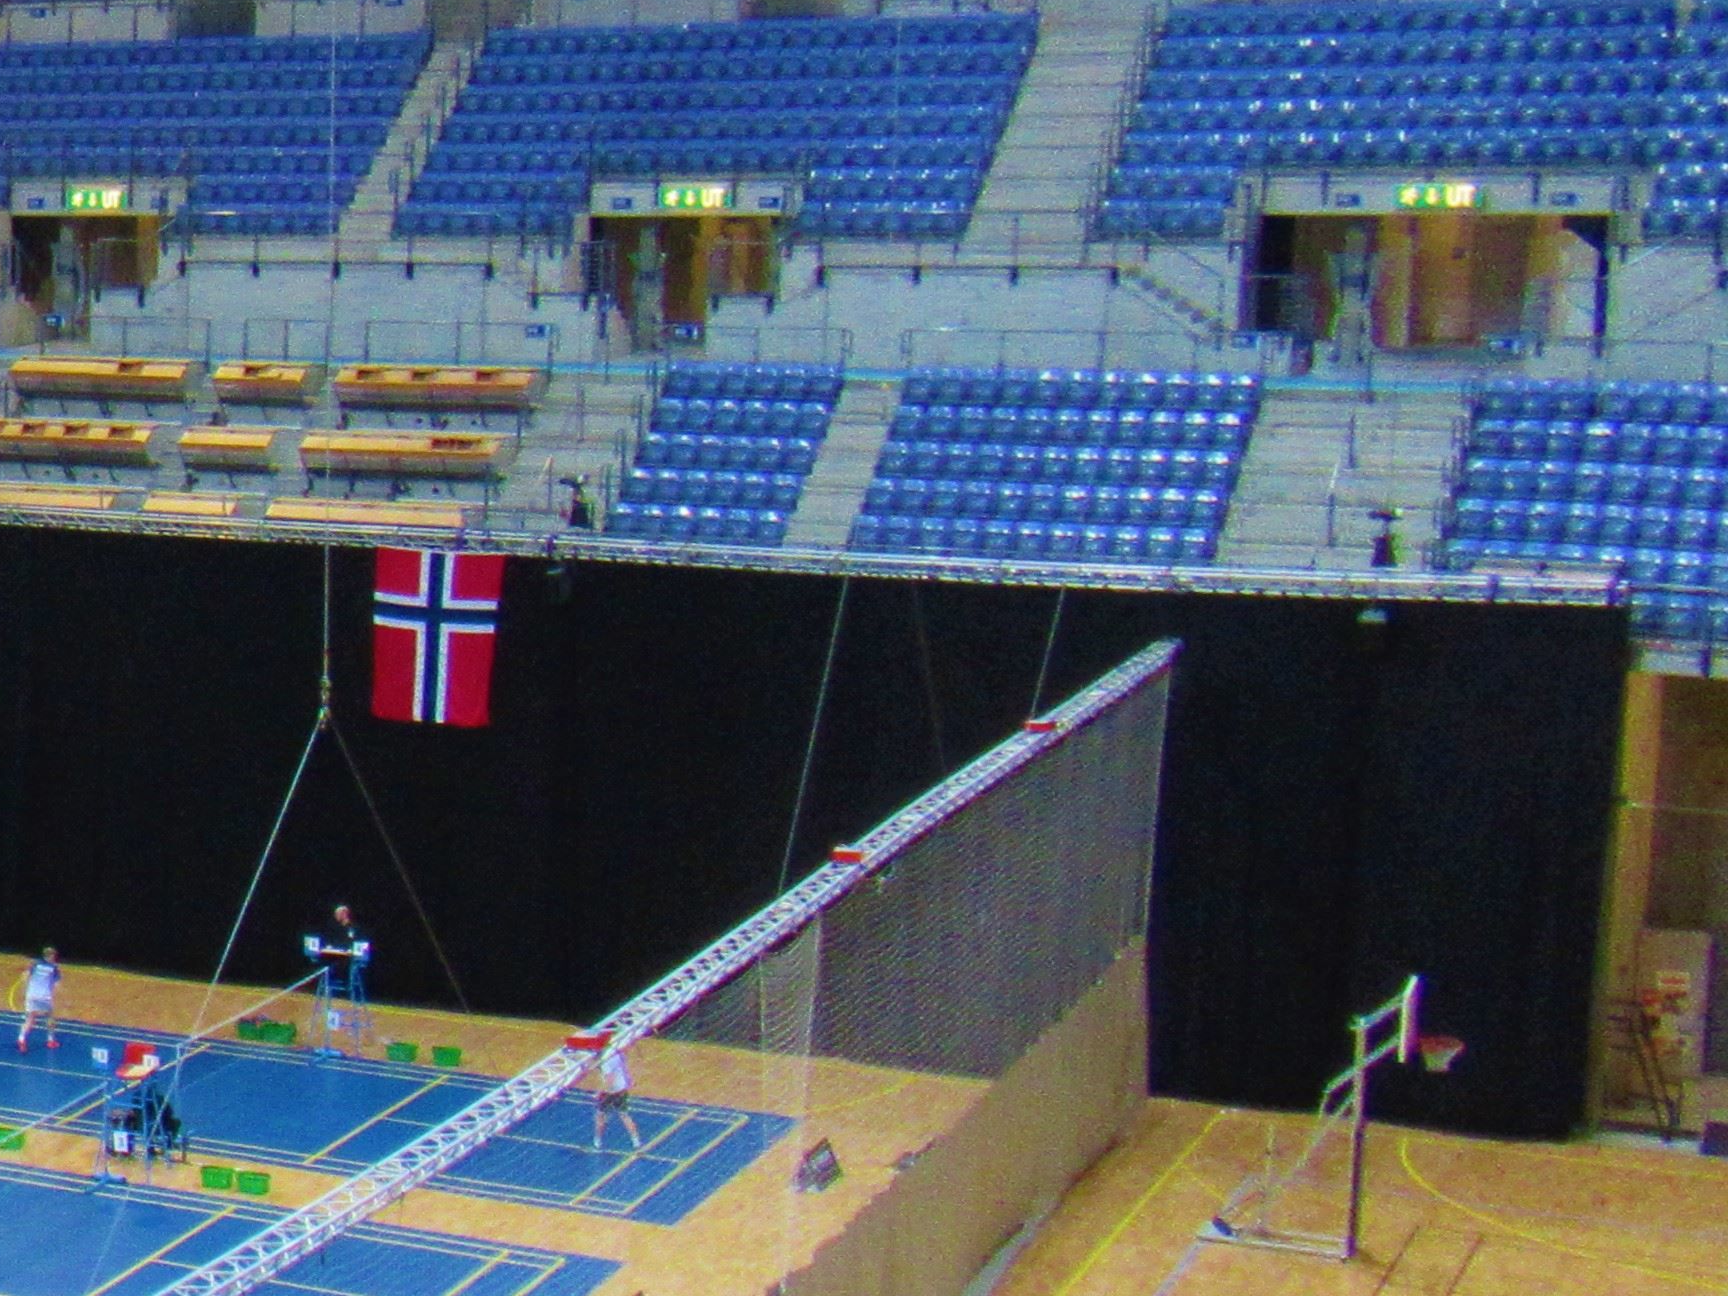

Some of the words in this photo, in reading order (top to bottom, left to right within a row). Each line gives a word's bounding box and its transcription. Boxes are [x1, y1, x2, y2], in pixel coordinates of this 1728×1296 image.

[102, 191, 122, 208] UT
[701, 188, 724, 207] UT
[1444, 184, 1475, 207] UT
